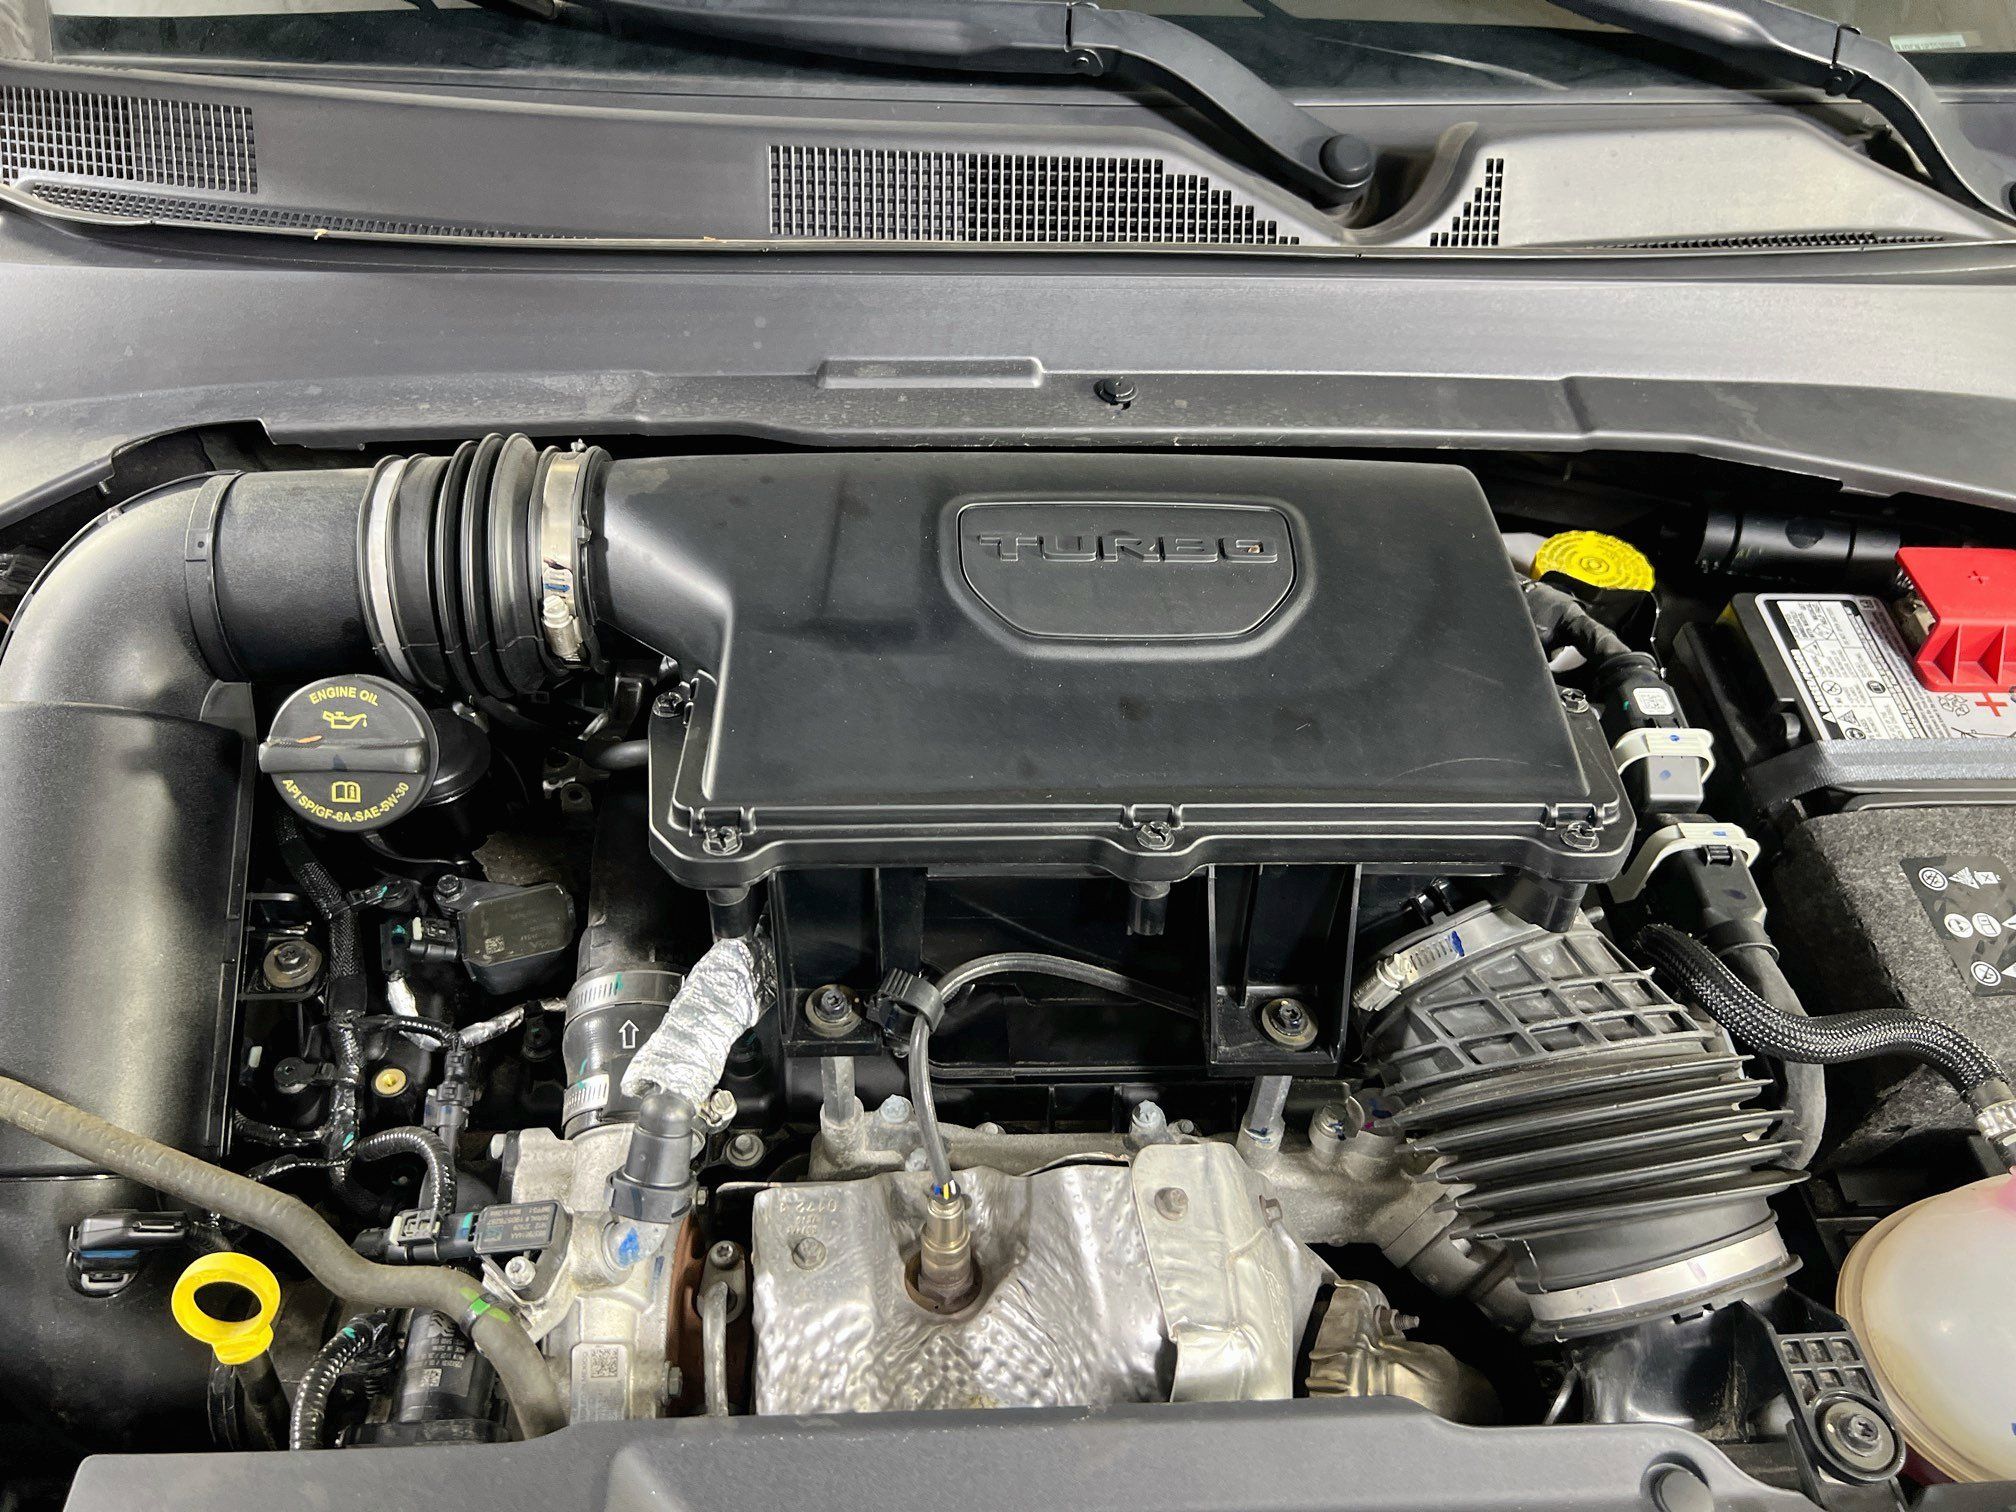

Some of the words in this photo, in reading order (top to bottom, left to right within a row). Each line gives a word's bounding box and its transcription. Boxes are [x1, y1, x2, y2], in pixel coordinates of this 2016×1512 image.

[978, 535, 1278, 563] TURBO
[309, 687, 357, 704] ENGINE
[359, 689, 379, 706] OIL
[282, 779, 301, 799] API
[298, 782, 409, 823] SP/GF-6A-SAE-5W-30
